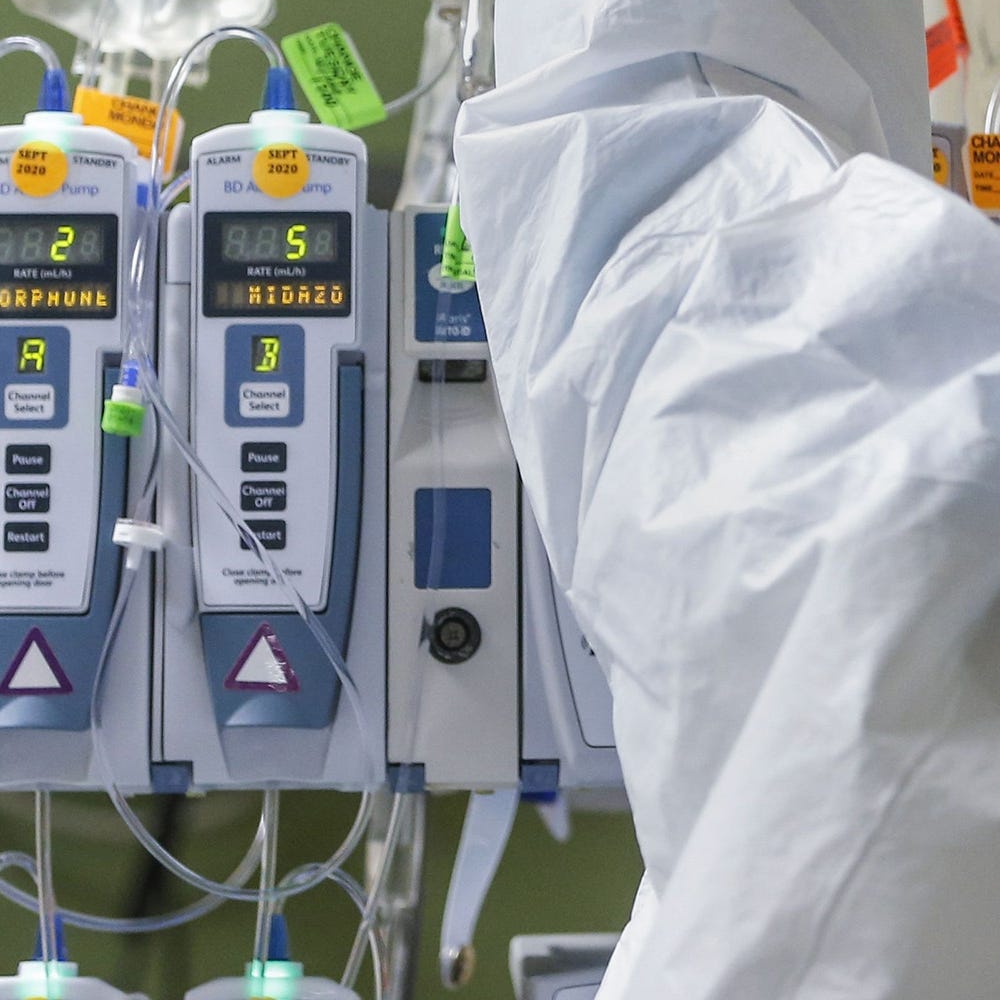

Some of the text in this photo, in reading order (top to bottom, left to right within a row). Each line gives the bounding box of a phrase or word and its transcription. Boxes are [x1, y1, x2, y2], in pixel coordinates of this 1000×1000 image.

[19, 149, 48, 160] SEPT
[268, 149, 298, 160] SEPT
[73, 155, 117, 168] STANDBY
[206, 155, 241, 166] ALARM
[17, 163, 47, 175] 2020
[267, 163, 298, 174] 2020
[224, 181, 243, 193] BD
[303, 183, 332, 195] ump
[51, 225, 75, 261] 2
[286, 224, 307, 261] 5
[14, 267, 38, 279] RATE
[247, 266, 306, 277] RATE (mL/h)
[20, 338, 46, 371] A
[8, 390, 51, 400] Channel
[243, 388, 286, 399] Channel
[14, 404, 44, 413] Select
[249, 402, 280, 411] Select
[12, 454, 43, 465] Pause
[248, 452, 279, 463] Pause
[6, 487, 49, 498] Channel
[242, 485, 286, 496] Channel
[19, 499, 37, 510] Off
[254, 497, 273, 508] Off
[7, 531, 45, 543] Restart
[257, 530, 282, 541] start
